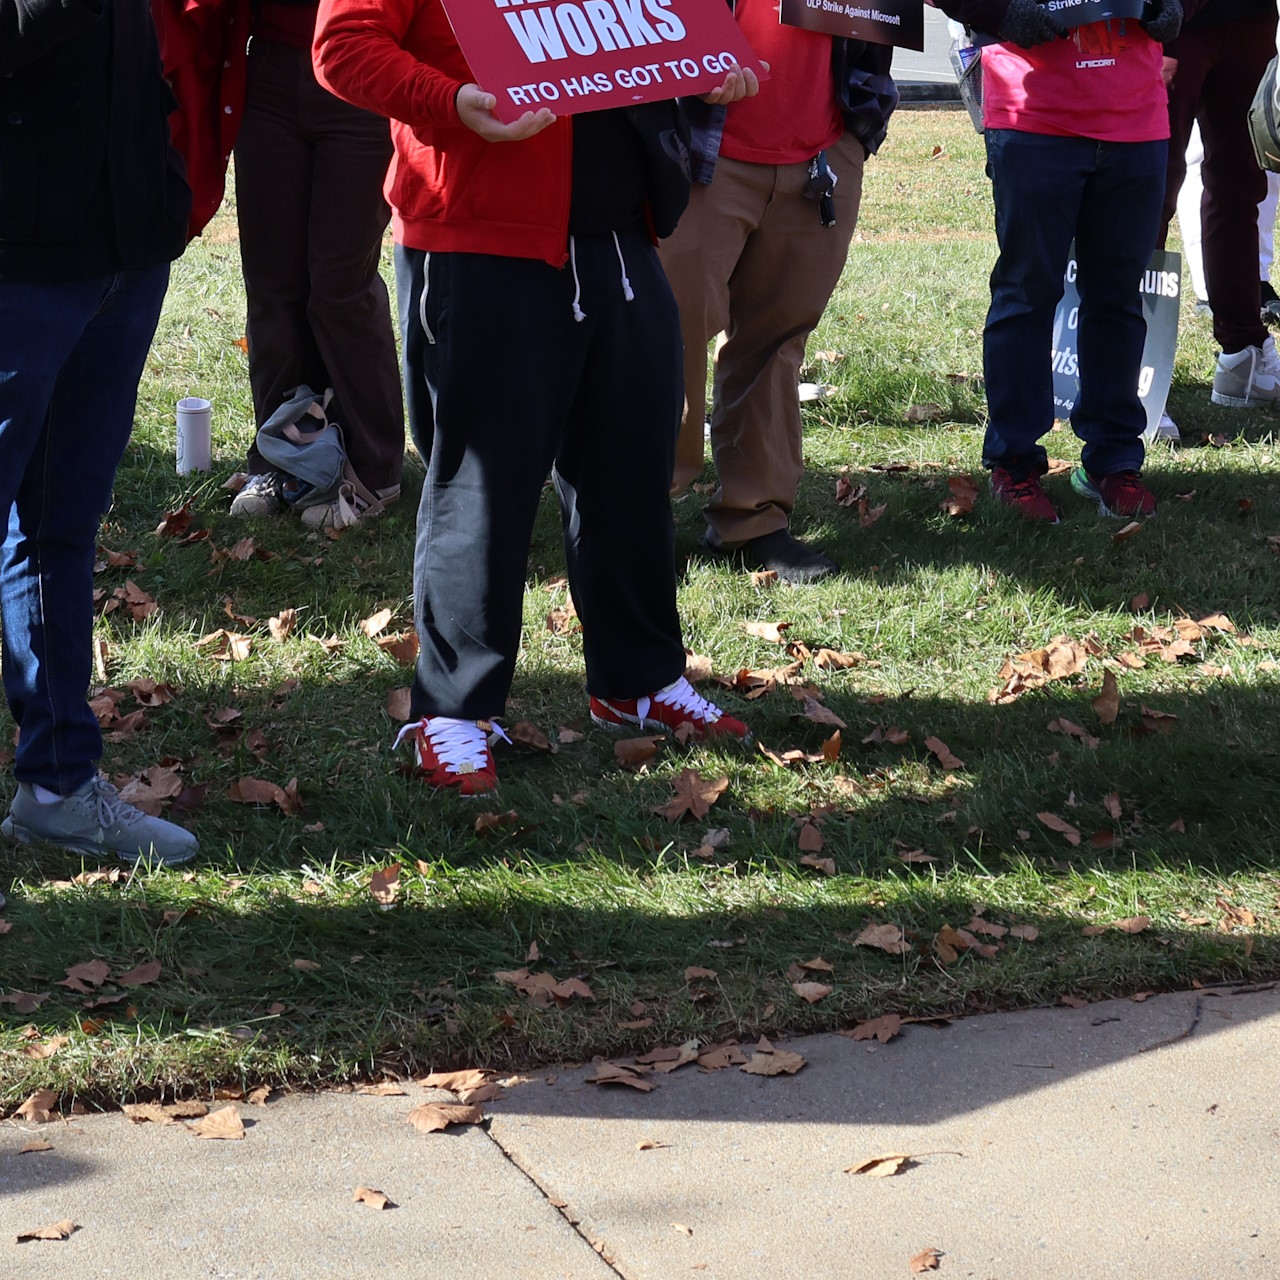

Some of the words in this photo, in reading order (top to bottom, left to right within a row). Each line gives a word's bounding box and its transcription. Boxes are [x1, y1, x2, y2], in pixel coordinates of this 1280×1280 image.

[822, 0, 844, 14] Strike
[844, 4, 871, 19] Against
[871, 9, 901, 26] Microsoft
[506, 81, 560, 106] RTO
[560, 72, 613, 97] HAS
[614, 63, 663, 89] GOT
[664, 58, 700, 80] TO
[701, 51, 738, 74] GO
